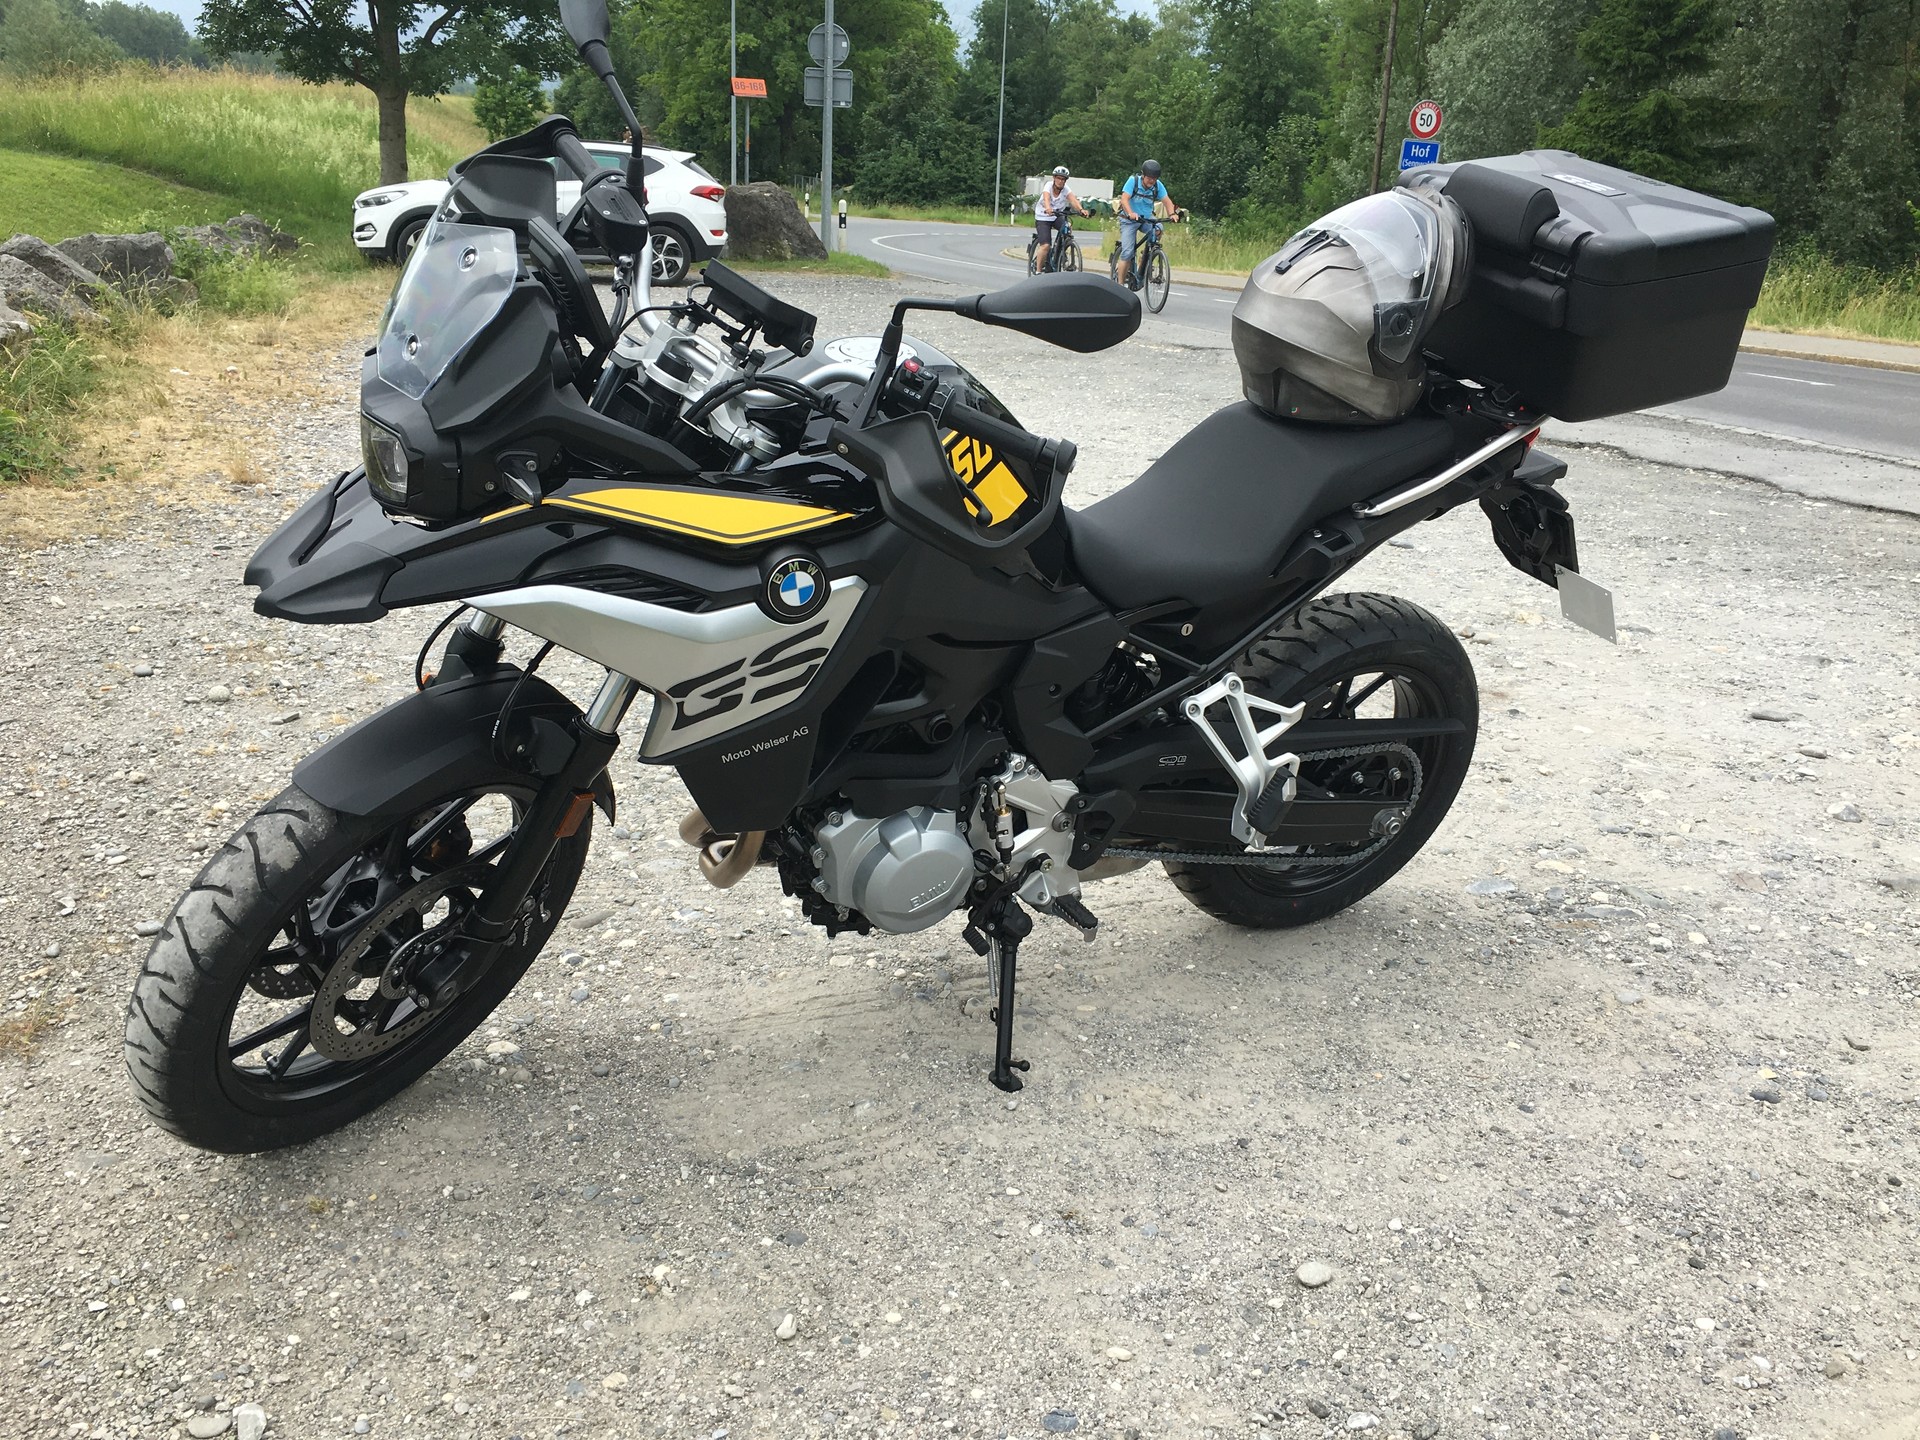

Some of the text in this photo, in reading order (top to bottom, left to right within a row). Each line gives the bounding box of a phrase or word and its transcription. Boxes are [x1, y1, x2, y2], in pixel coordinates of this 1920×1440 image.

[734, 81, 765, 91] 86-168
[1415, 102, 1440, 113] GENERELL
[1419, 113, 1433, 127] 50
[1410, 144, 1431, 158] Hof
[772, 561, 819, 585] BMW
[665, 619, 830, 731] GS
[721, 725, 809, 764] Moto Walser AG
